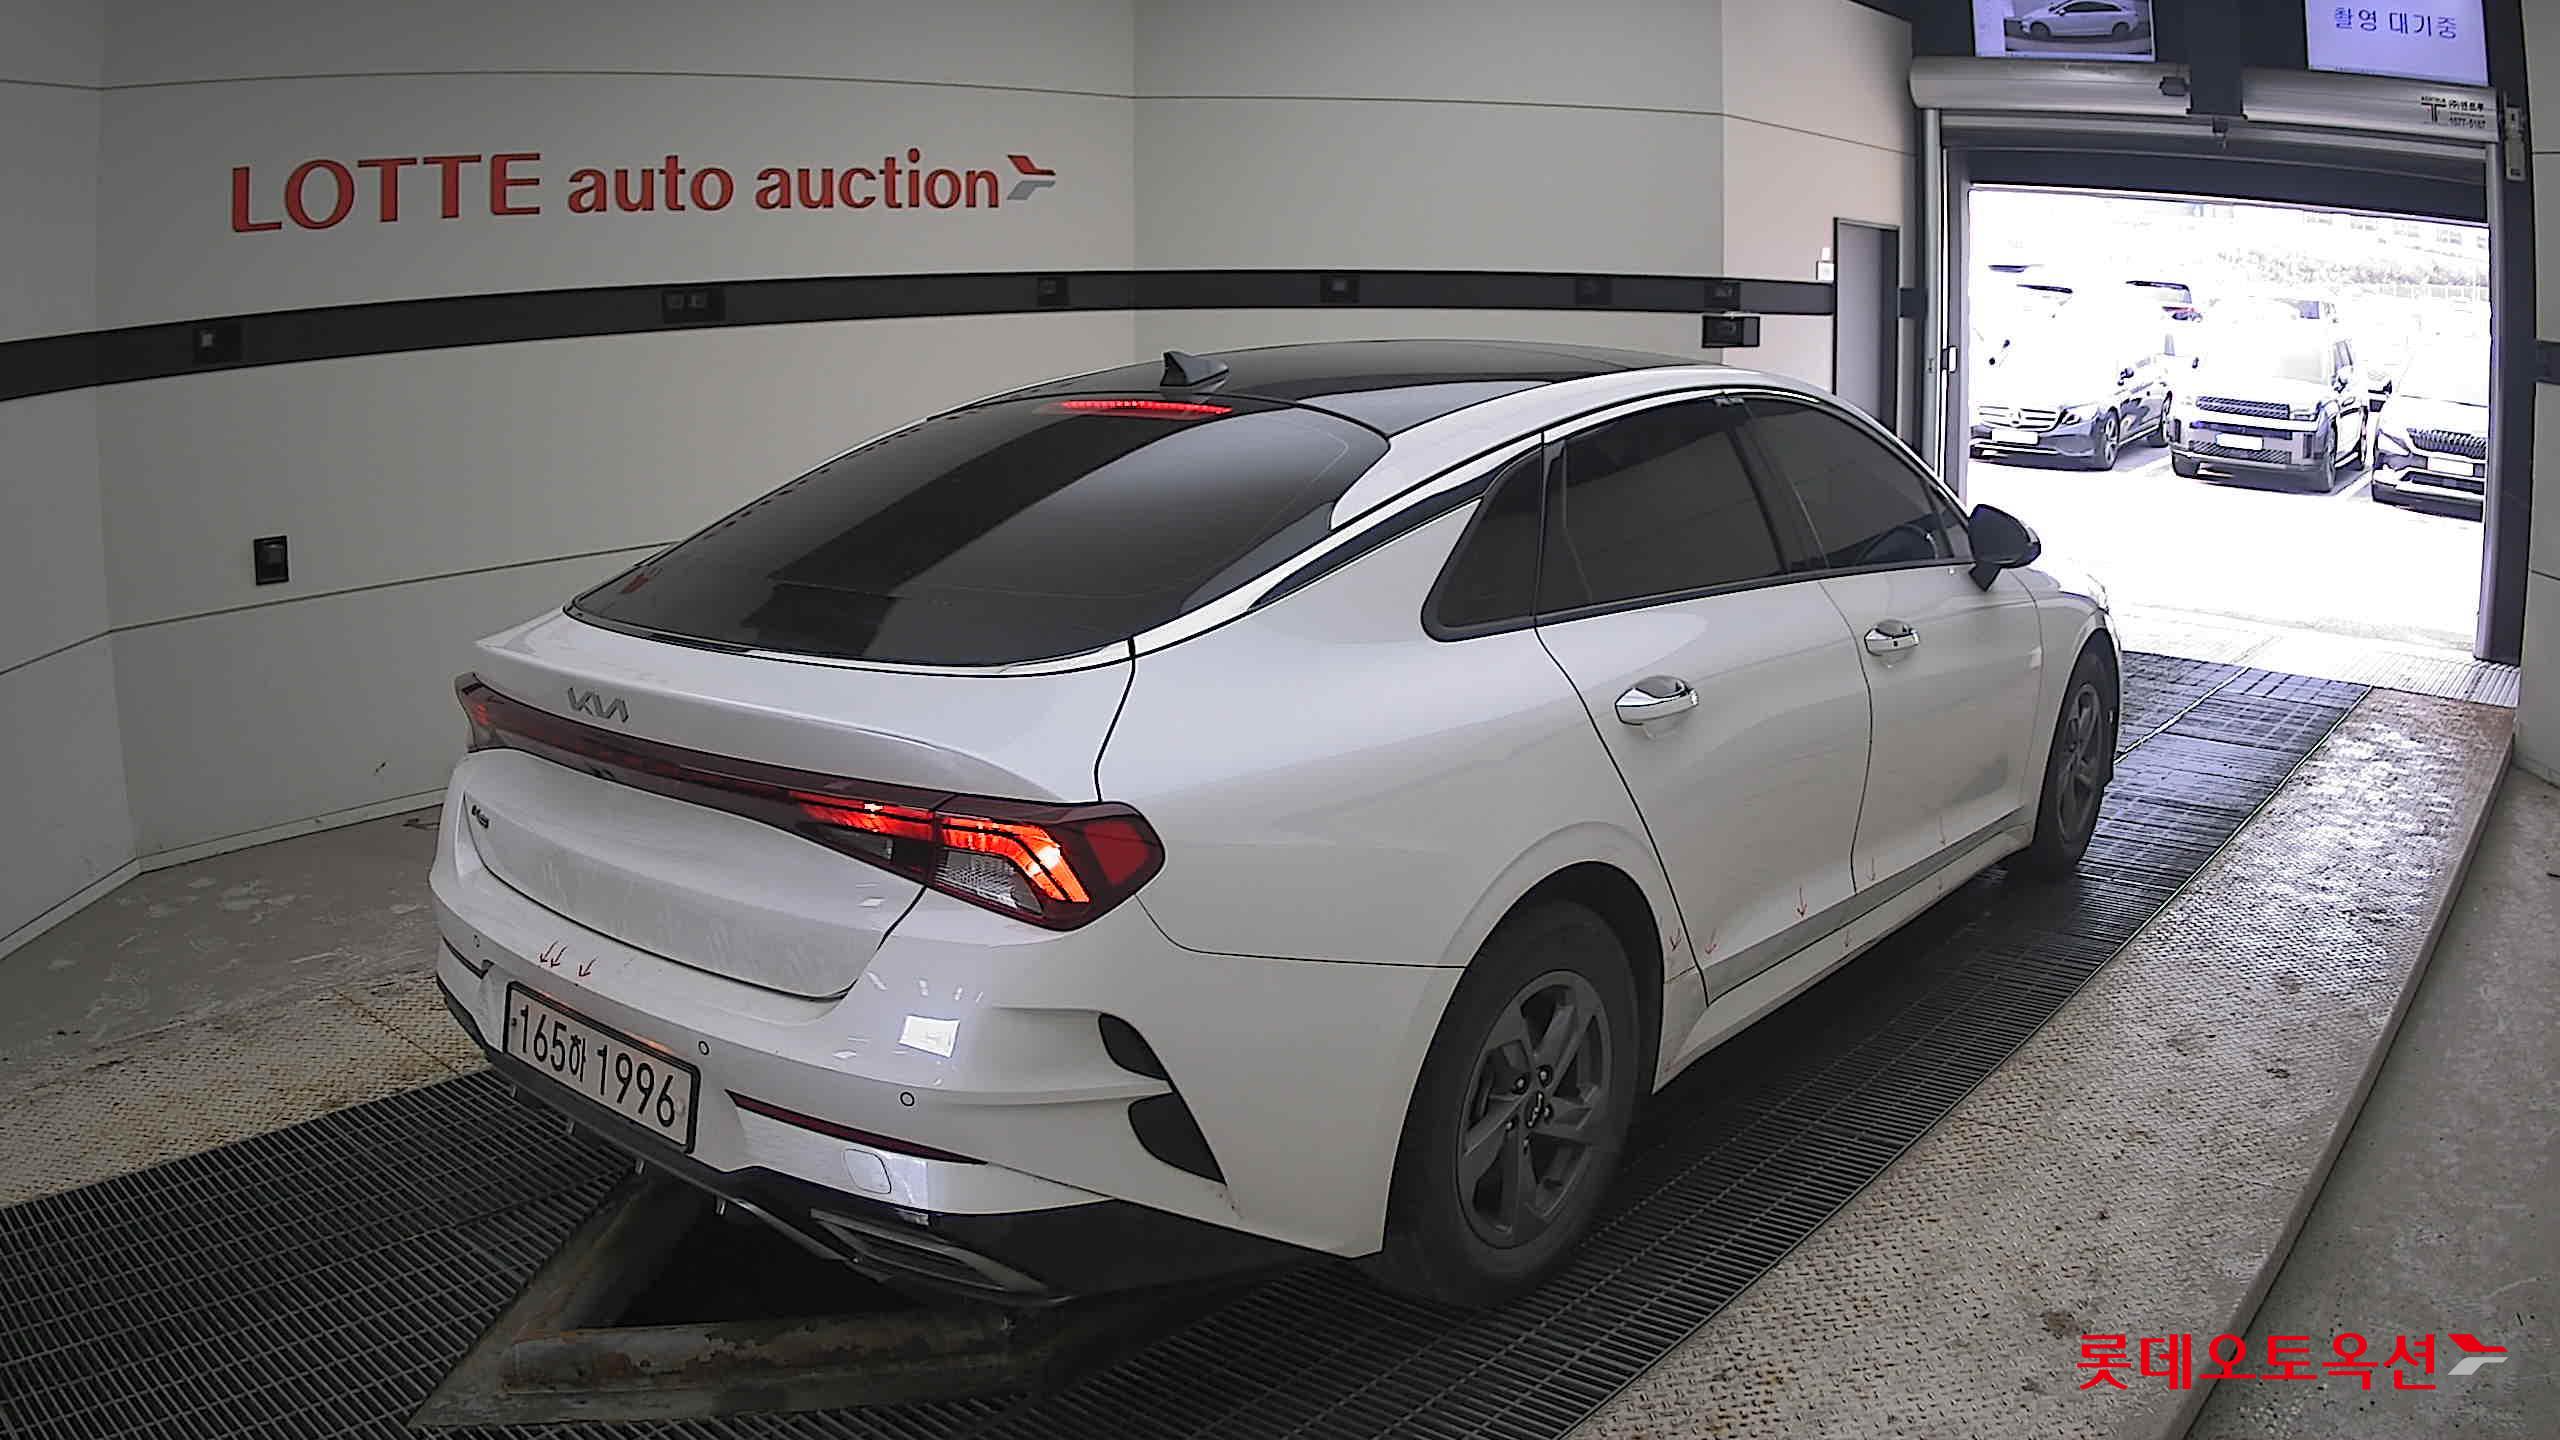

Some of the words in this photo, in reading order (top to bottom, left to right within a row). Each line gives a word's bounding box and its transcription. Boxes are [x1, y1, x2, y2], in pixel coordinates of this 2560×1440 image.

[2390, 12, 2457, 39] 대기중
[233, 153, 539, 233] LOTTE
[569, 156, 737, 213] auto
[756, 148, 1001, 210] auction
[568, 687, 629, 722] KIA
[520, 1004, 588, 1083] 165하
[596, 1044, 677, 1128] 1996
